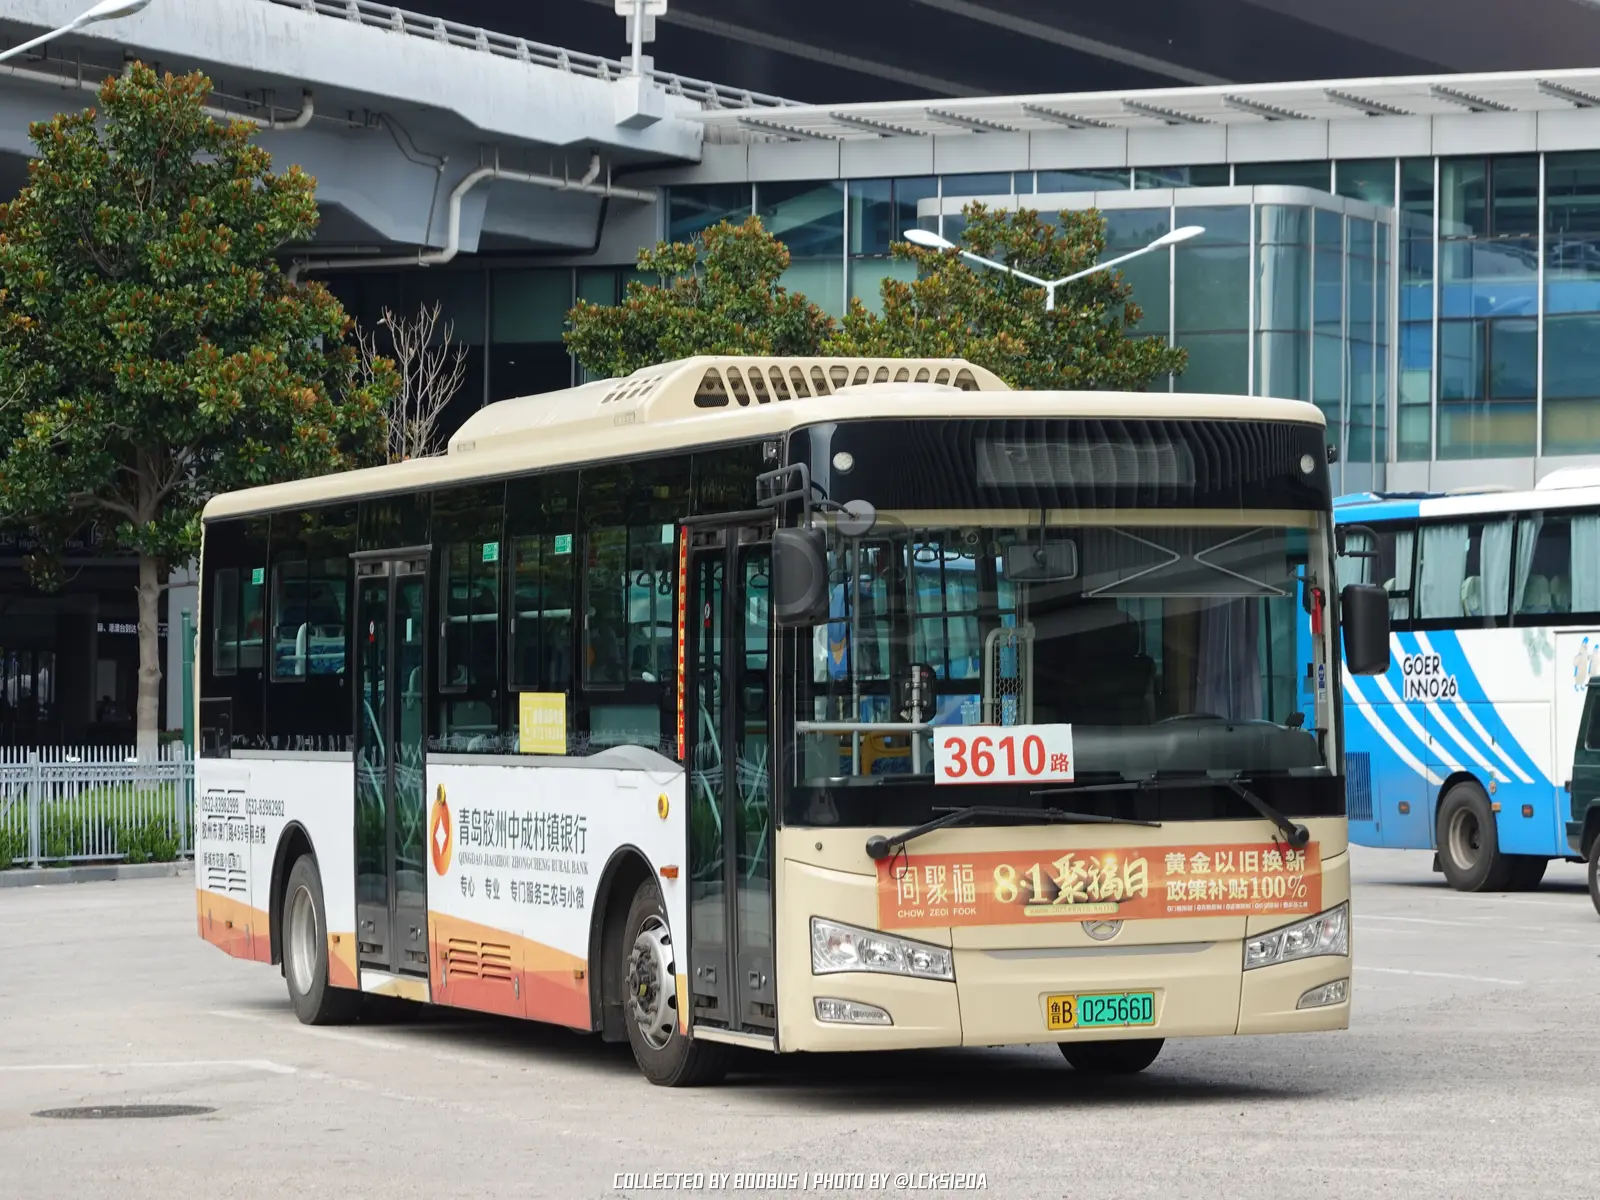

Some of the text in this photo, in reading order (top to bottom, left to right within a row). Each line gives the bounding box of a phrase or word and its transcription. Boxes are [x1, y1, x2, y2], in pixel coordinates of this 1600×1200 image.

[1403, 655, 1440, 676] GOER
[459, 807, 587, 855] 青岛胶州中成村镇银行
[458, 852, 589, 875] QINGDAO JIAOZHOU ZHONGCHENG RURAL BANK
[1165, 850, 1306, 876] 黄金以旧换新
[460, 874, 585, 909] 专心 专业 专门服务三农与小微
[896, 863, 976, 905] 周聚福
[1166, 875, 1308, 901] 政策补贴100%
[897, 909, 925, 919] CHOW
[953, 907, 977, 917] FOOK
[1050, 997, 1153, 1025] 鲁B 02566D
